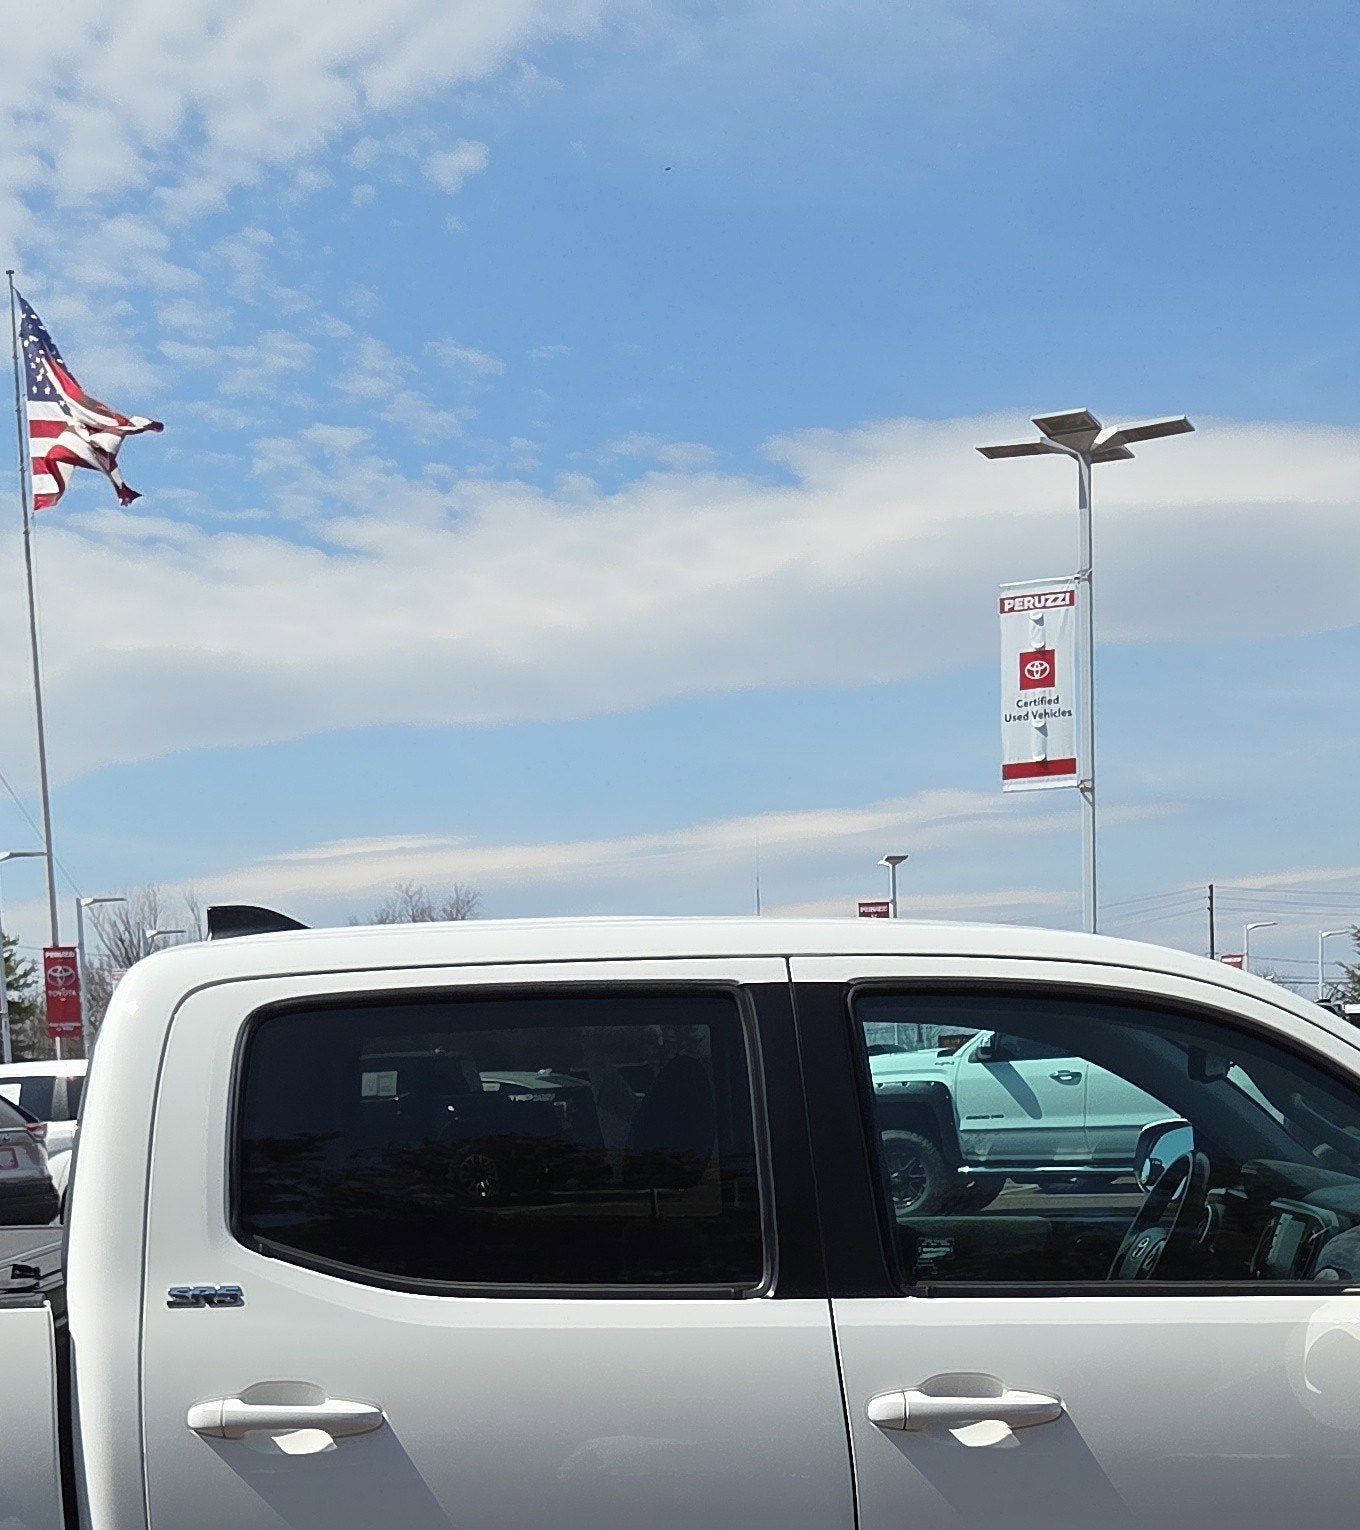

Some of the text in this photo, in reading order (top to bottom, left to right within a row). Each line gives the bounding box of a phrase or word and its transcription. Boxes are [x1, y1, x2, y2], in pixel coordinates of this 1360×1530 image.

[1003, 592, 1071, 613] PERUZZI
[1016, 695, 1060, 709] Certified
[1004, 708, 1073, 723] Used Vehicles
